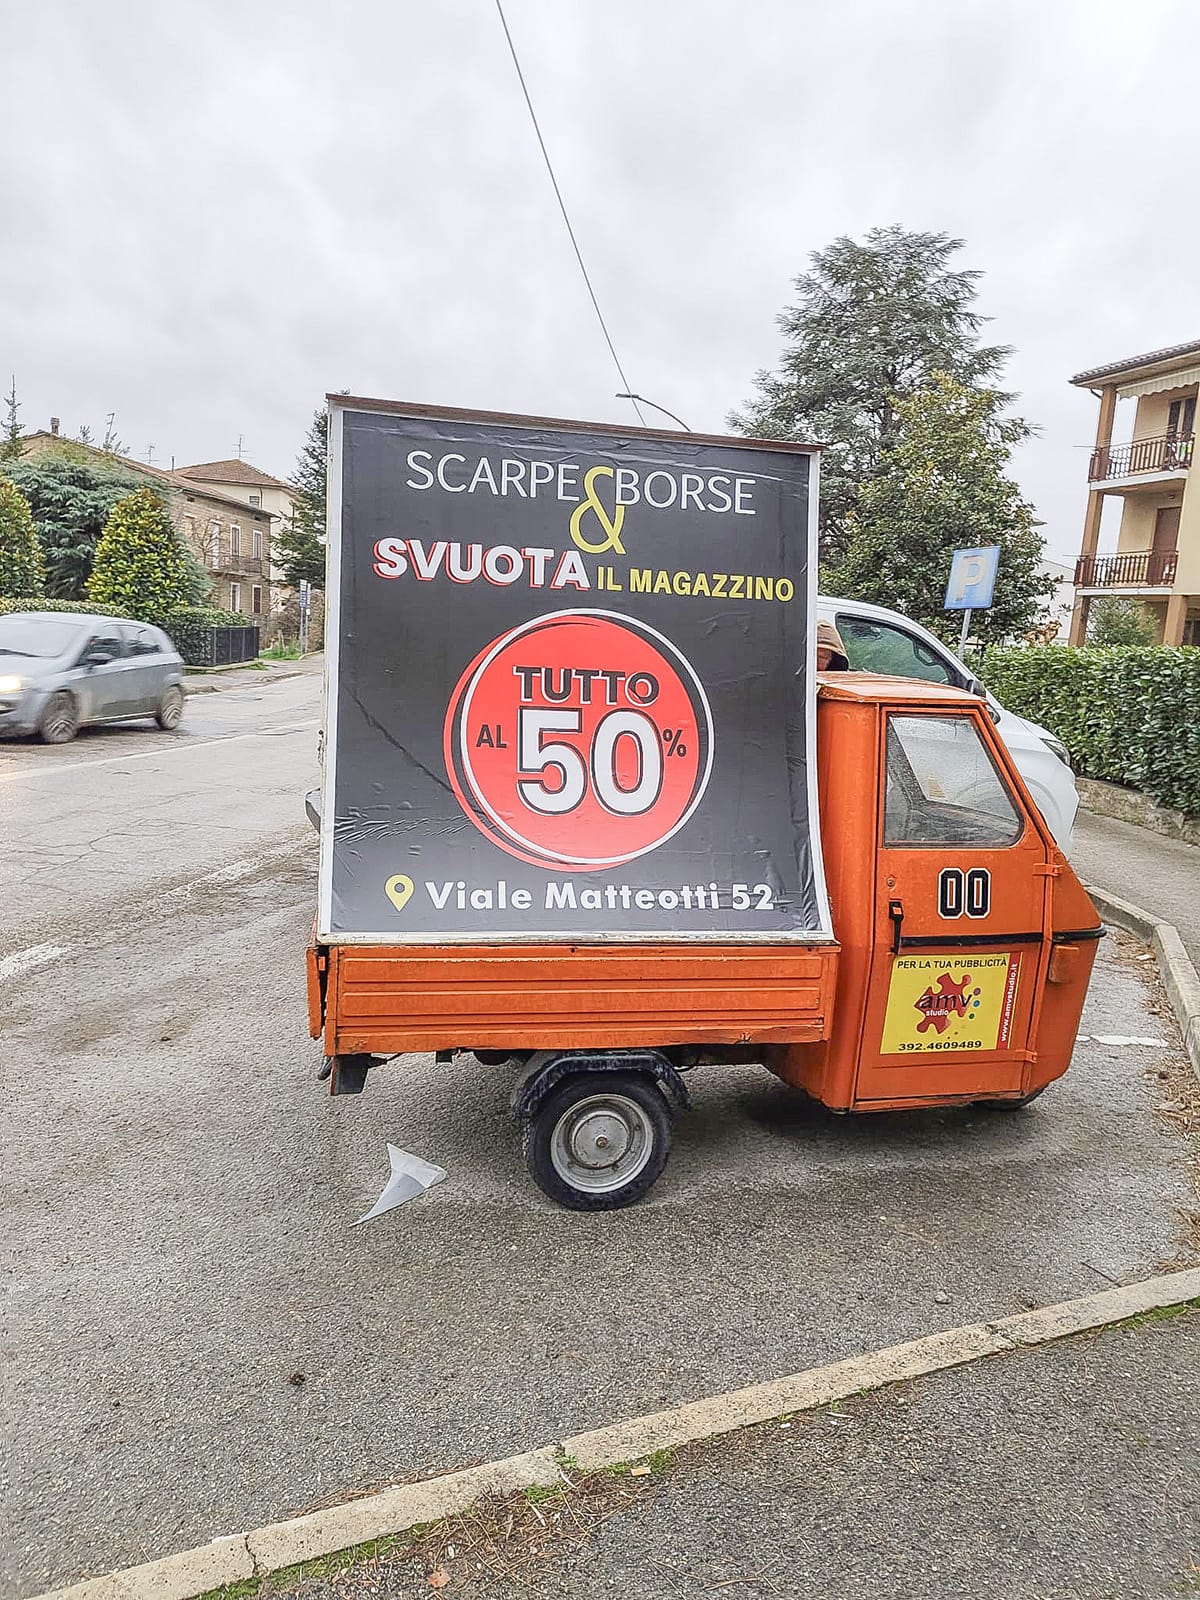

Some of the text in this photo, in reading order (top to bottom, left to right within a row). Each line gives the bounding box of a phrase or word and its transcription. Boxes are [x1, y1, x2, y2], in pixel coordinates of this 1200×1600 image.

[405, 450, 757, 555] SCARPE & BORSE
[373, 537, 795, 602] SVUOTA IL MAGAZZINO
[956, 555, 986, 601] P
[512, 665, 660, 707] TUTTO
[475, 724, 507, 749] AL
[516, 705, 665, 817] 50
[425, 880, 775, 912] Viale Matteotti 52
[937, 867, 992, 920] 00
[897, 957, 1008, 969] PER LA TUA PUBBLICITÀ
[919, 994, 973, 1009] amv
[925, 1008, 949, 1017] studio
[1001, 963, 1018, 1042] www.amvstudio.it
[898, 1040, 983, 1052] 392.4609489
